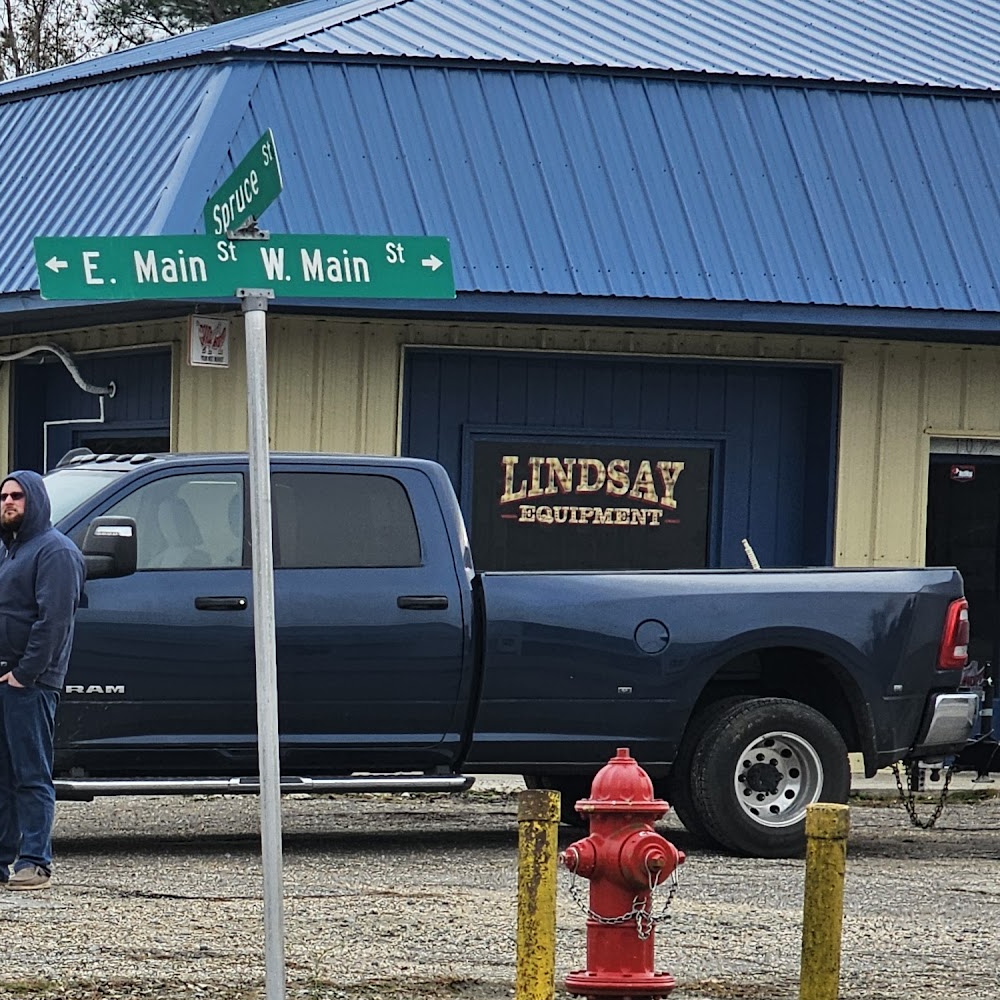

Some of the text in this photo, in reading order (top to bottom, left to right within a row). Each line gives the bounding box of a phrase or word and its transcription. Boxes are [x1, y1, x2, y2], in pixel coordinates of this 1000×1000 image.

[213, 141, 272, 235] Spruce St
[82, 240, 238, 285] E. Main St
[260, 242, 406, 283] W. Main St
[500, 455, 685, 510] LINDSAY
[518, 504, 664, 526] EQUIPMENT
[65, 685, 125, 694] RAM
